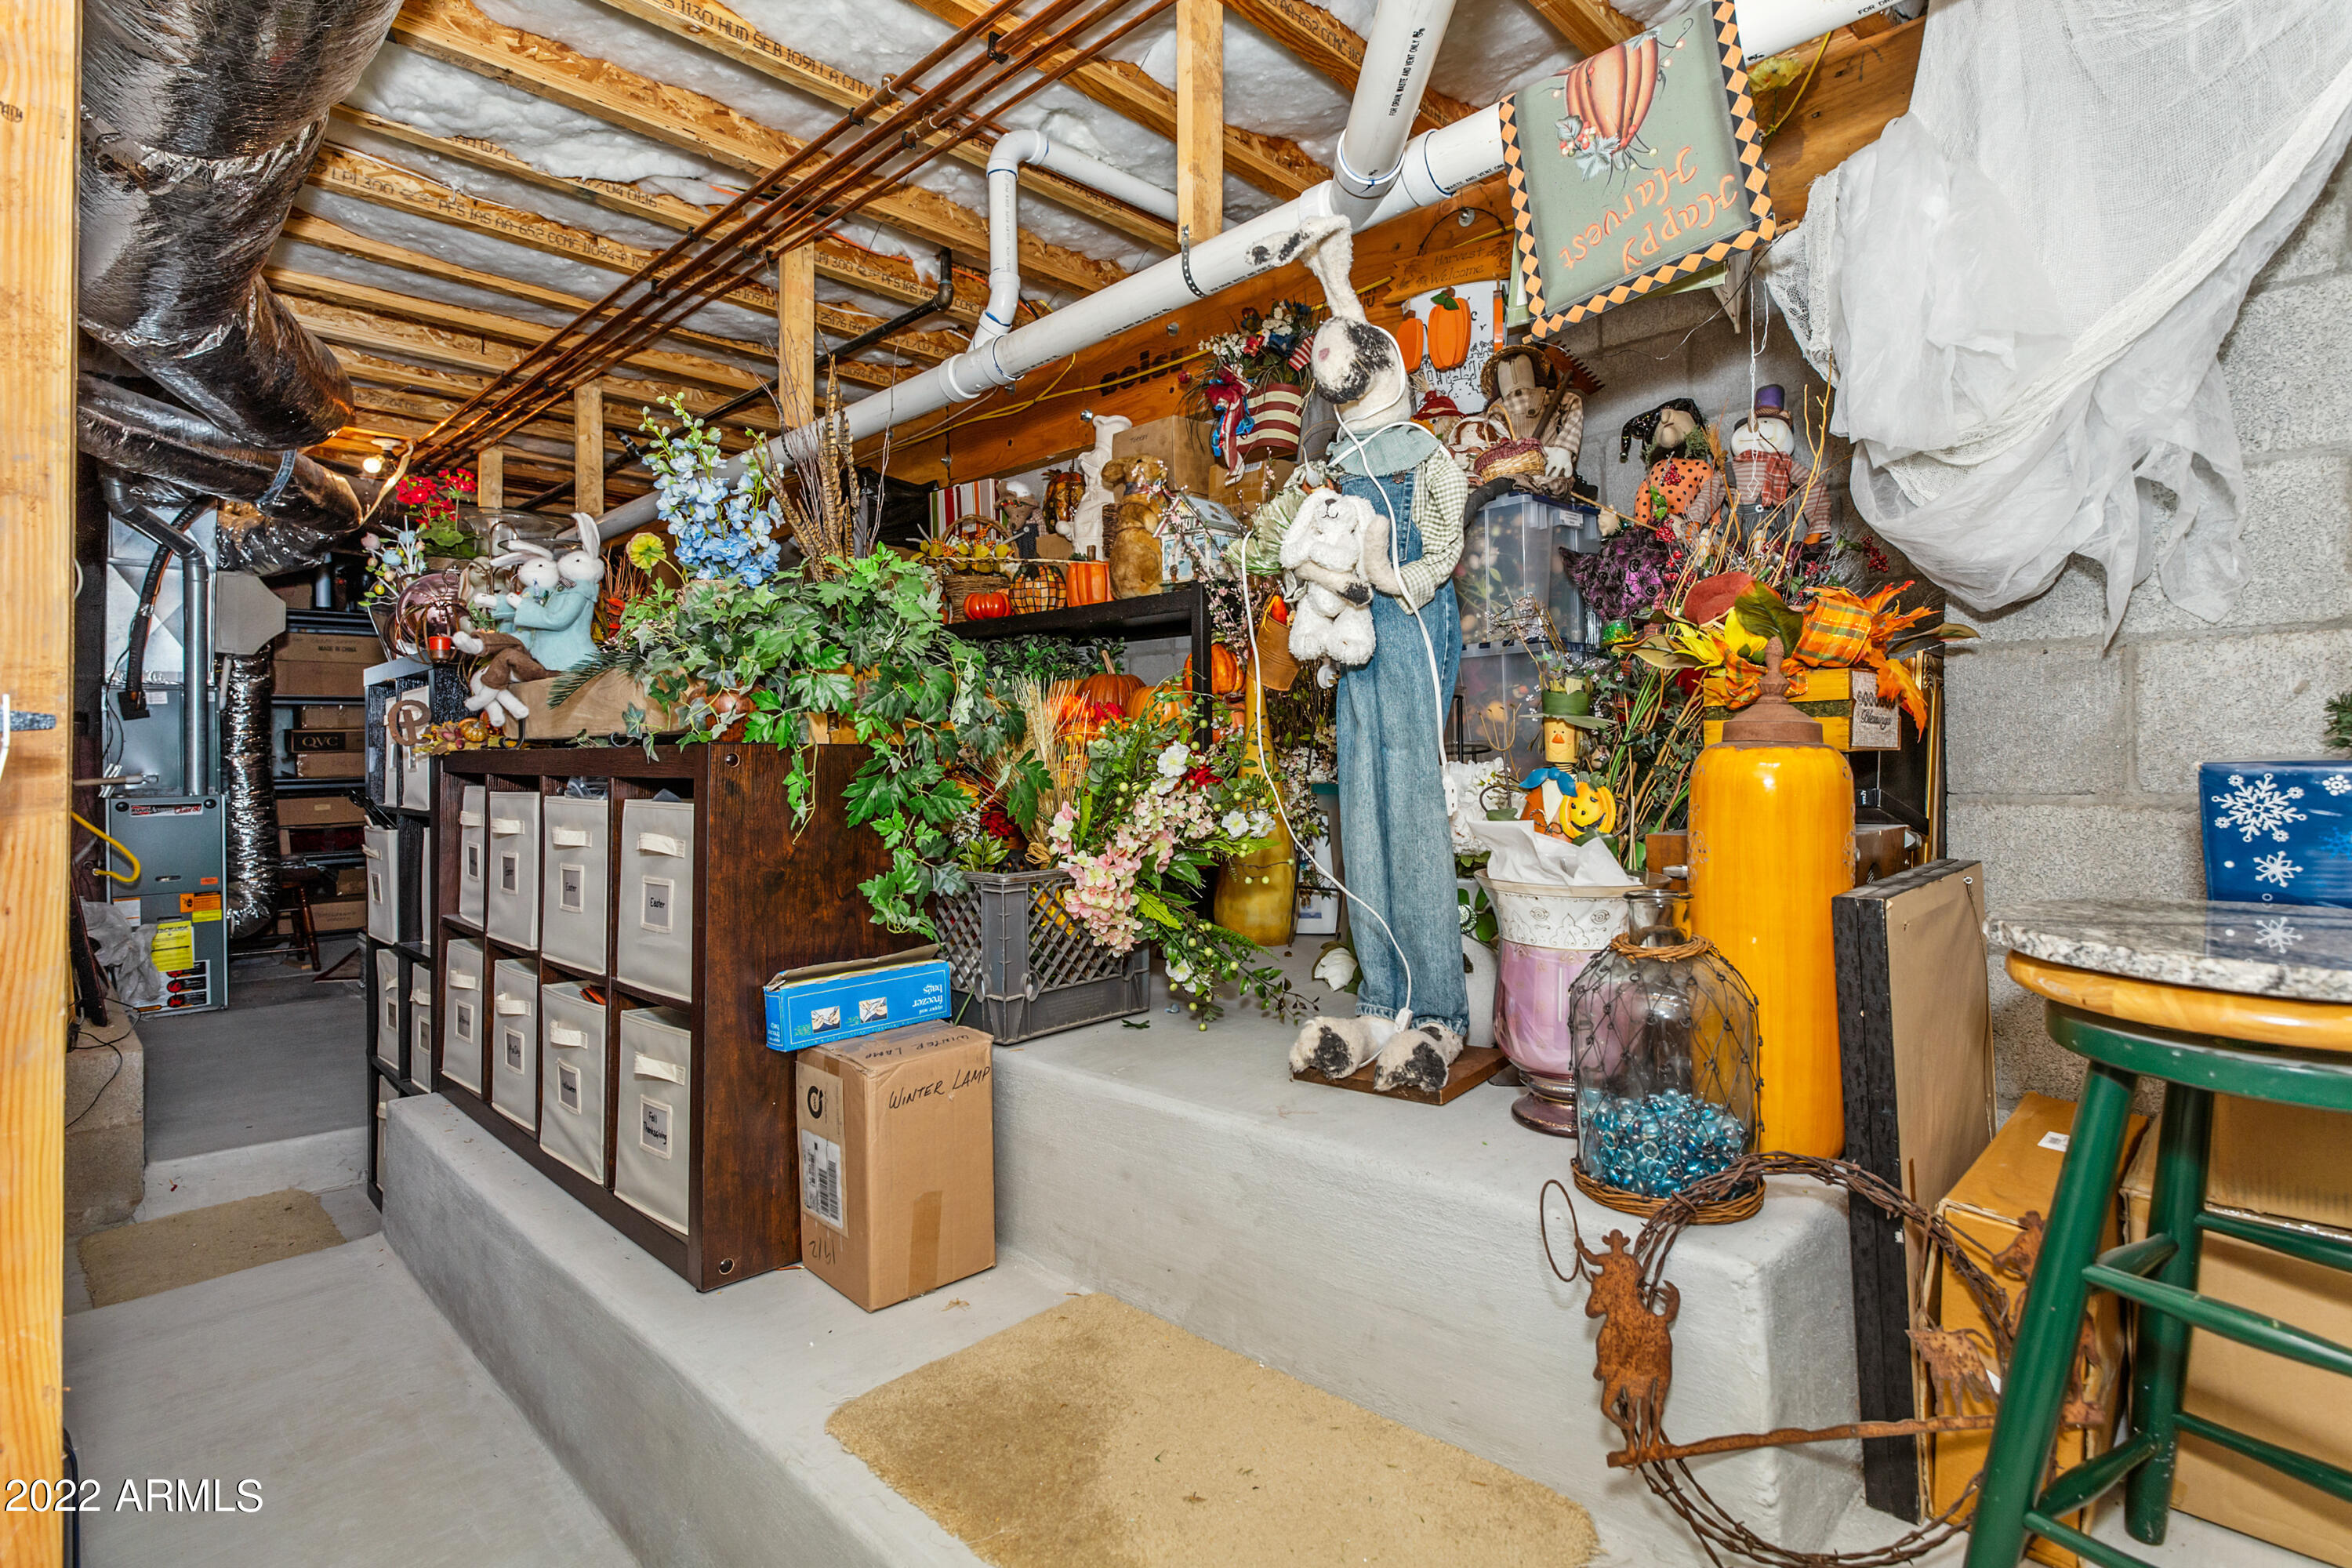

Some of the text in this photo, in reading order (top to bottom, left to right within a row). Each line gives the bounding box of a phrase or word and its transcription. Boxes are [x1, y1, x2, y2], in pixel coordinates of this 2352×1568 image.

[1857, 5, 1875, 15] FOR
[753, 32, 782, 58] SEB
[1410, 40, 1420, 53] ONLY
[1405, 54, 1416, 66] VENT
[1478, 169, 1494, 177] VENT
[360, 176, 394, 195] 300
[438, 198, 466, 218] PFS
[1559, 146, 1697, 270] Harvest
[1621, 173, 1738, 274] Happy
[1434, 246, 1486, 267] Harvest
[832, 257, 854, 273] 300
[1430, 264, 1485, 285] Welcome
[1860, 709, 1892, 730] Blessings
[302, 736, 339, 748] QVC
[649, 897, 665, 909] Easter
[923, 983, 943, 994] bags
[912, 995, 943, 1008] freezer
[865, 1035, 970, 1059] WINTER LAMP
[888, 1066, 990, 1109] WINTER LAMP
[648, 1111, 658, 1124] Fall
